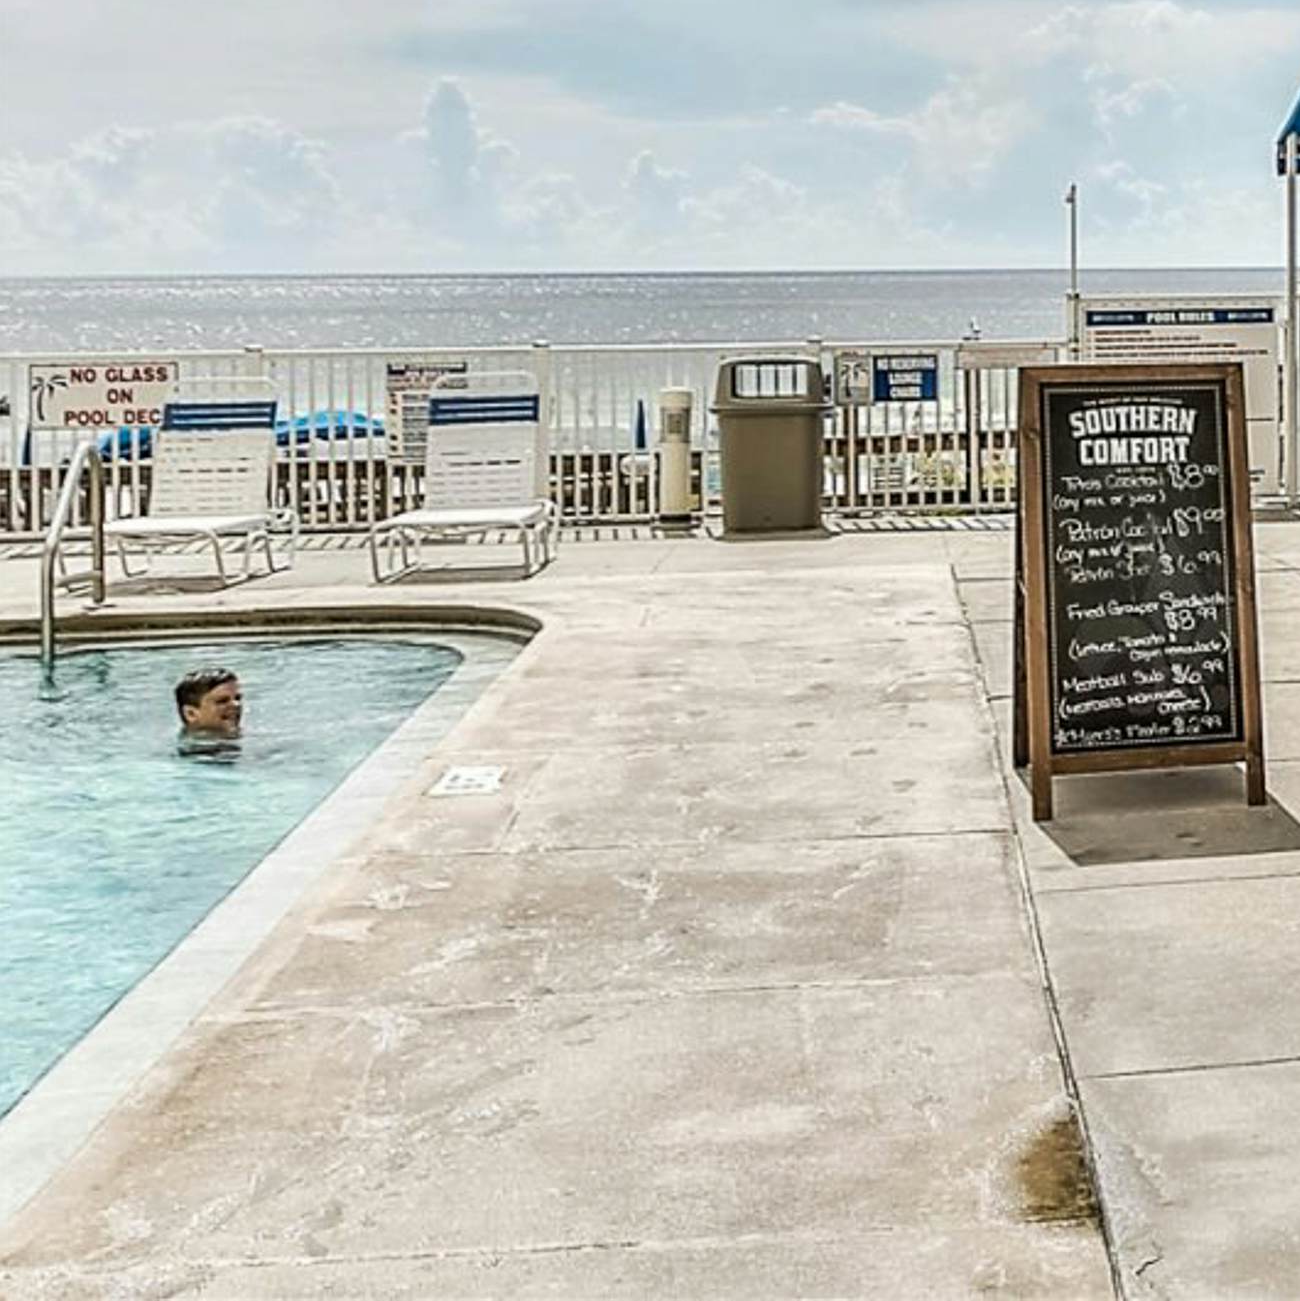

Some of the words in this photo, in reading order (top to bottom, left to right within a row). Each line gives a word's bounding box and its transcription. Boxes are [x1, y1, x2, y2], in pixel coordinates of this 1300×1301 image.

[70, 369, 97, 384] NO
[105, 367, 168, 383] GLASS
[106, 388, 133, 404] ON
[63, 410, 115, 426] POOL
[123, 409, 162, 424] DEC
[1069, 404, 1197, 439] SOUTHERN
[1079, 435, 1190, 466] COMFORT
[1066, 602, 1106, 620] Fried
[1107, 599, 1160, 616] Grouper
[1062, 672, 1127, 692] Meatball
[1131, 668, 1166, 685] Sub
